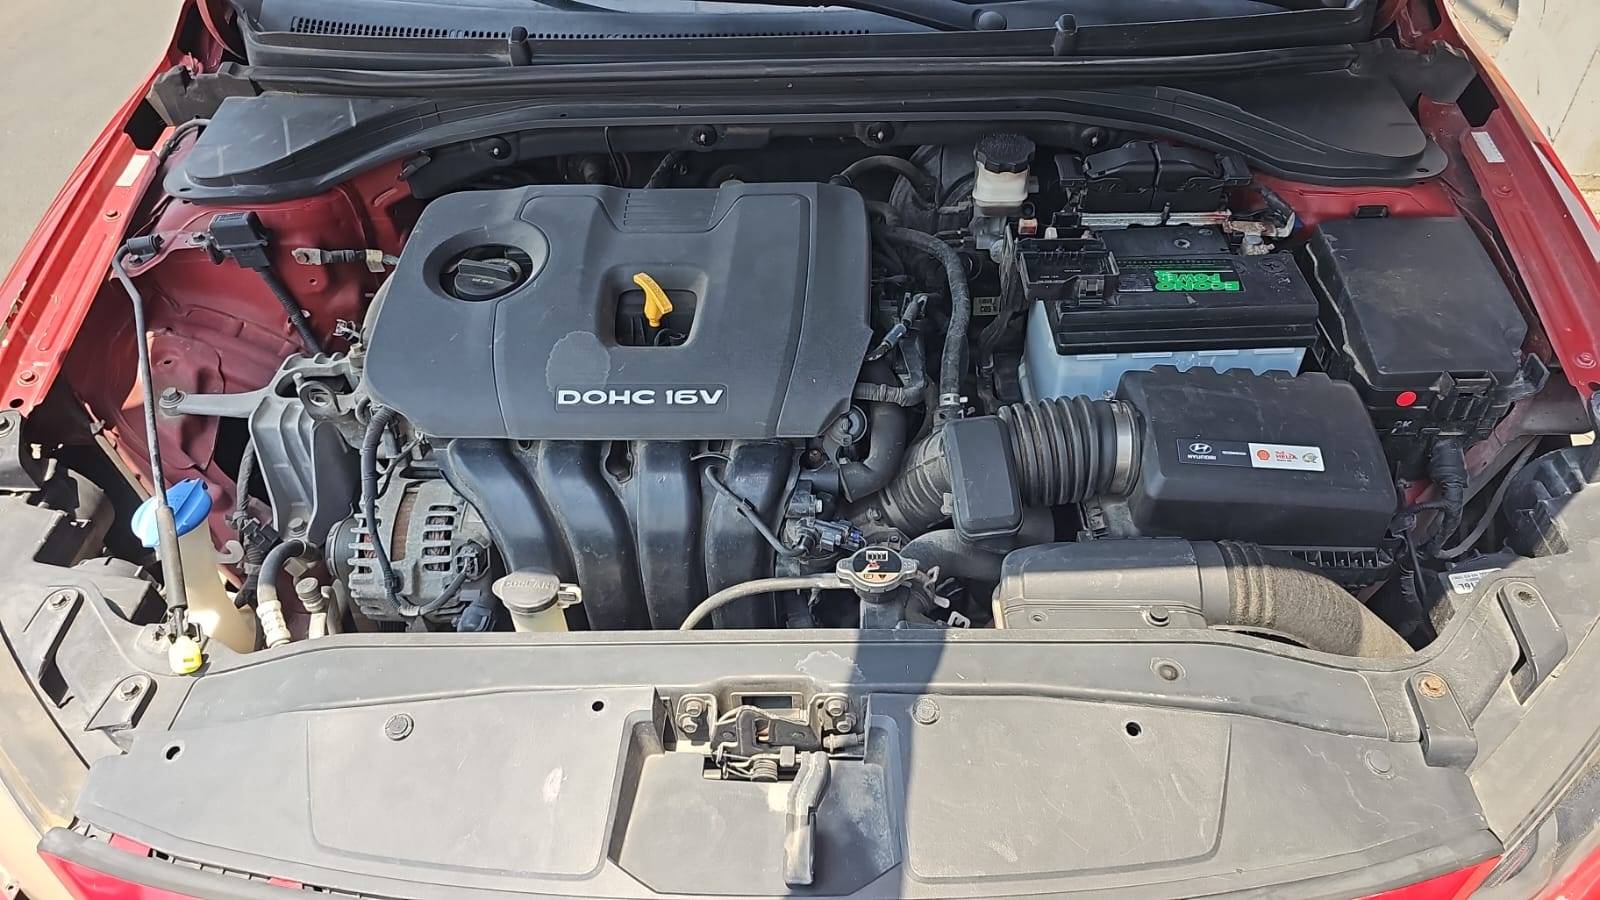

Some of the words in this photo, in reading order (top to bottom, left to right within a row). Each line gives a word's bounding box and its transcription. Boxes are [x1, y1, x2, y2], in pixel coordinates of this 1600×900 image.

[1154, 270, 1221, 283] POWER
[1155, 280, 1240, 291] ECONO
[557, 389, 656, 405] DOHC
[665, 389, 724, 405] 16V
